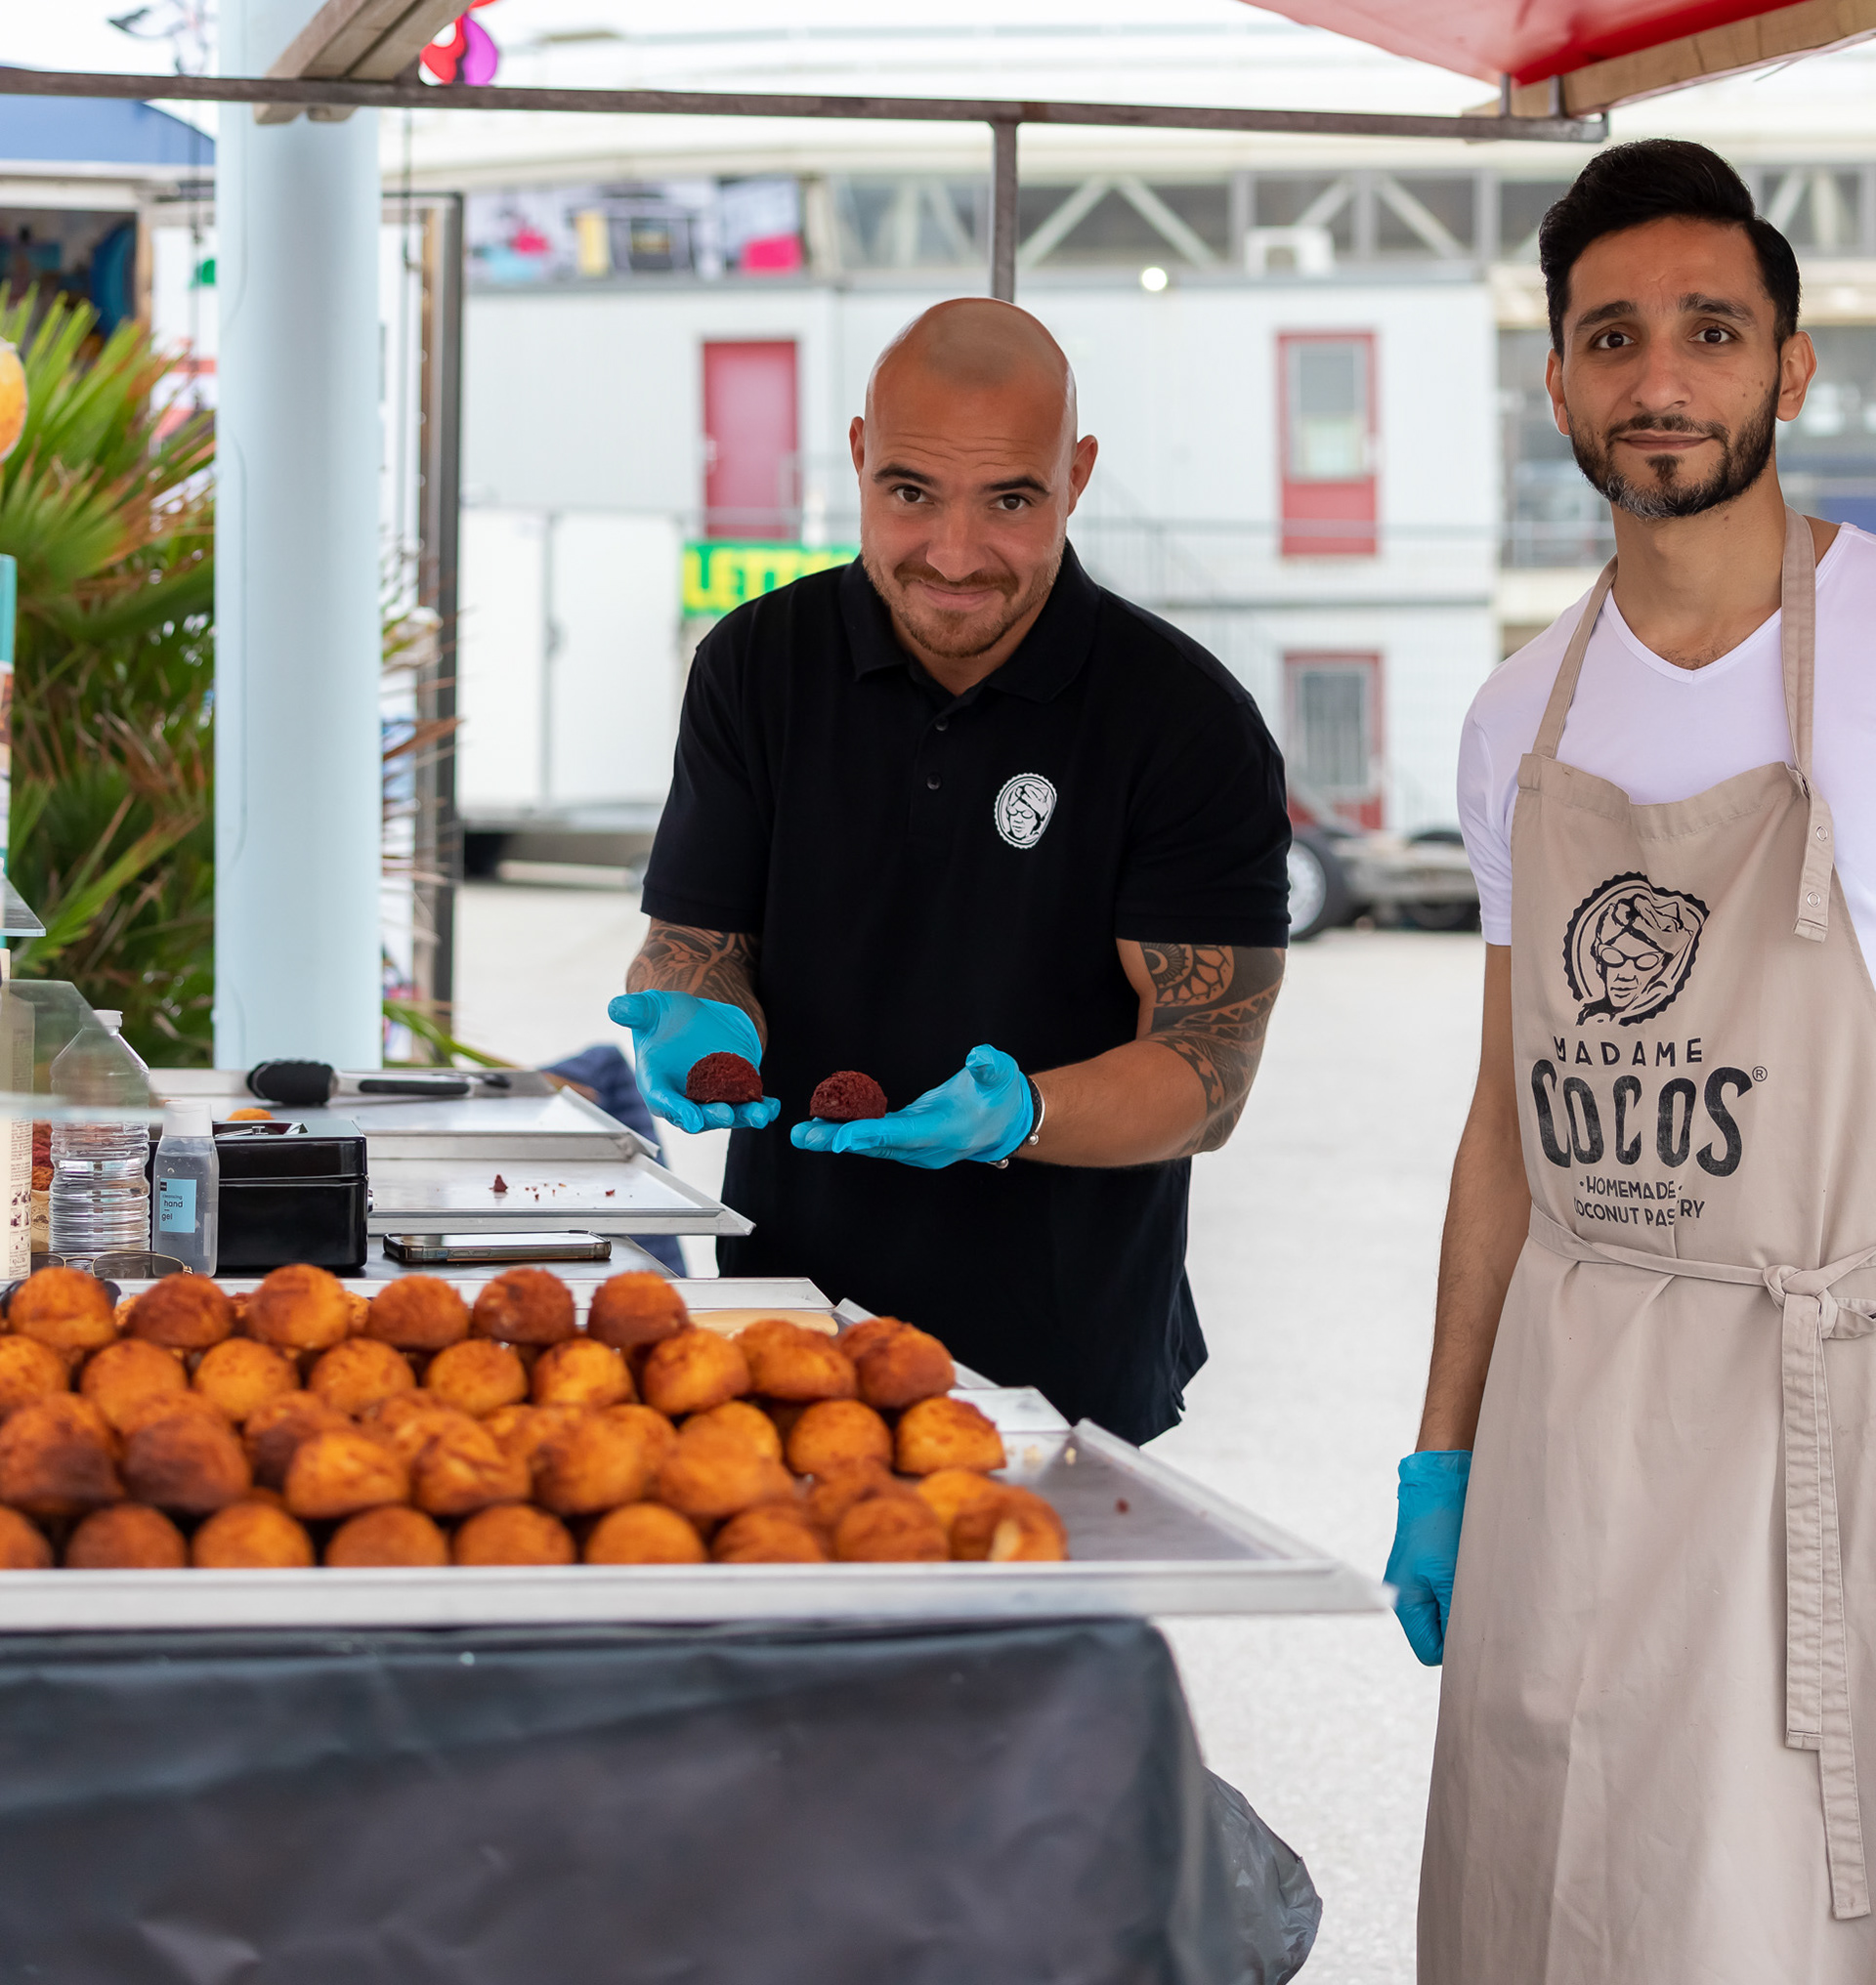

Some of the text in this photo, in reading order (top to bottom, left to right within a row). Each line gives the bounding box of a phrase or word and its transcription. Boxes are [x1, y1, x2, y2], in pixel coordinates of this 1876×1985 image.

[1554, 1035, 1702, 1067] MADAME
[1531, 1059, 1753, 1177] COCOS
[1644, 1199, 1705, 1226] PASRY
